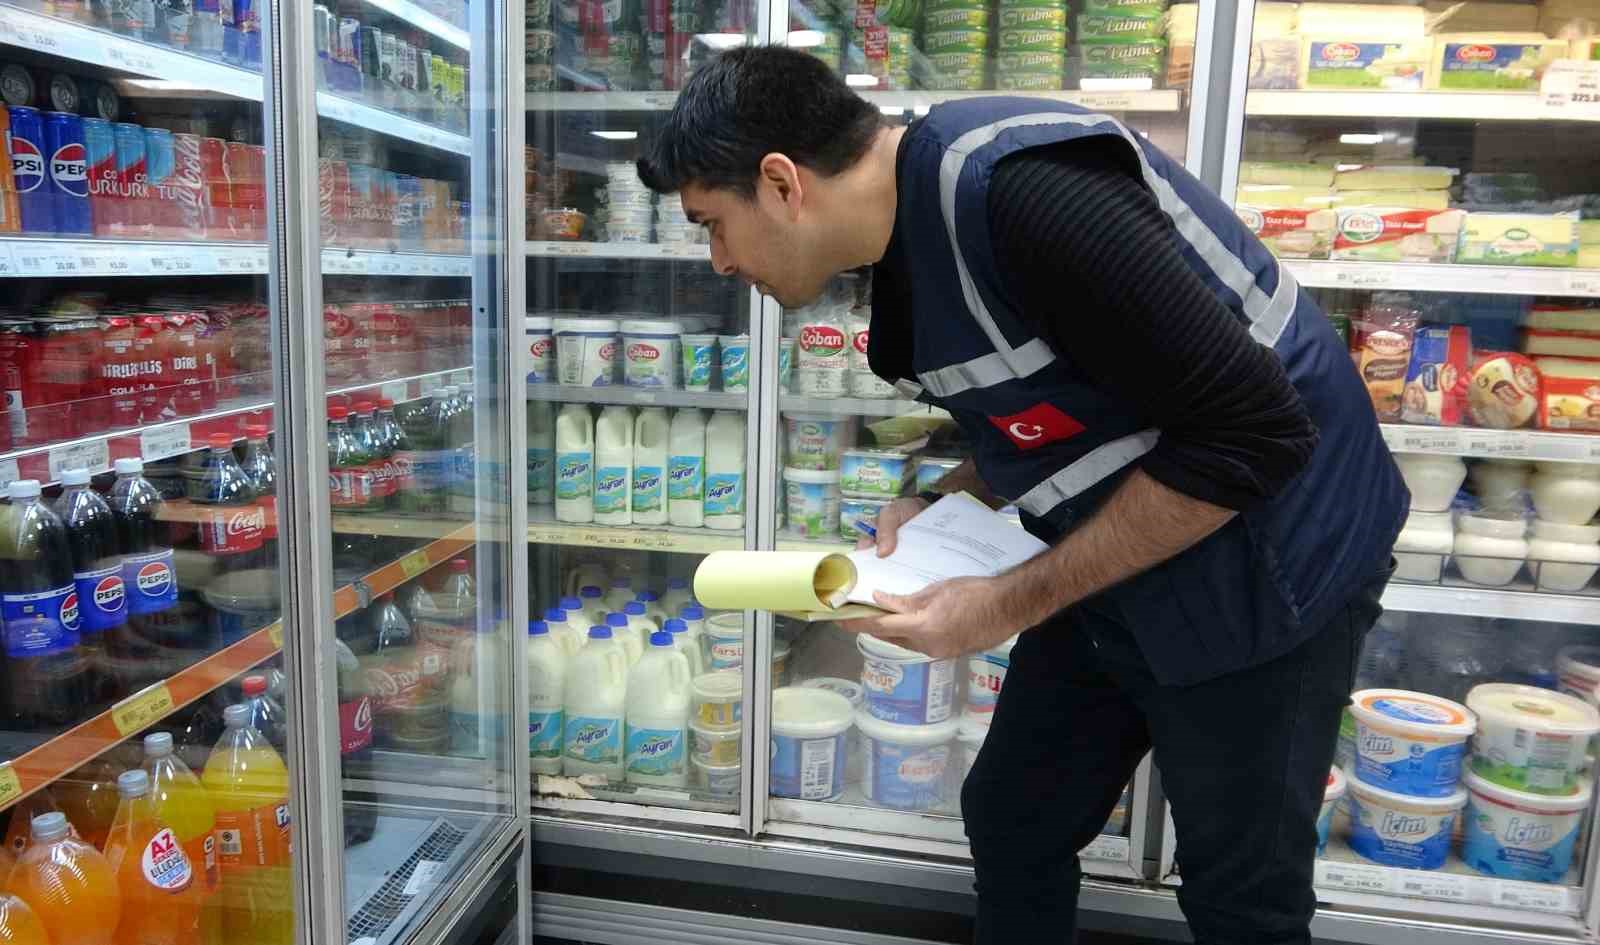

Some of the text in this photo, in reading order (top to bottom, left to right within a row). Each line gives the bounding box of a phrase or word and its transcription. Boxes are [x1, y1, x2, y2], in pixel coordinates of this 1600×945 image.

[13, 159, 42, 172] PSI
[54, 163, 87, 176] PEP
[708, 484, 737, 499] Ayran
[576, 727, 609, 744] Ayran
[640, 739, 673, 756] Ayran
[151, 831, 175, 860] AZ
